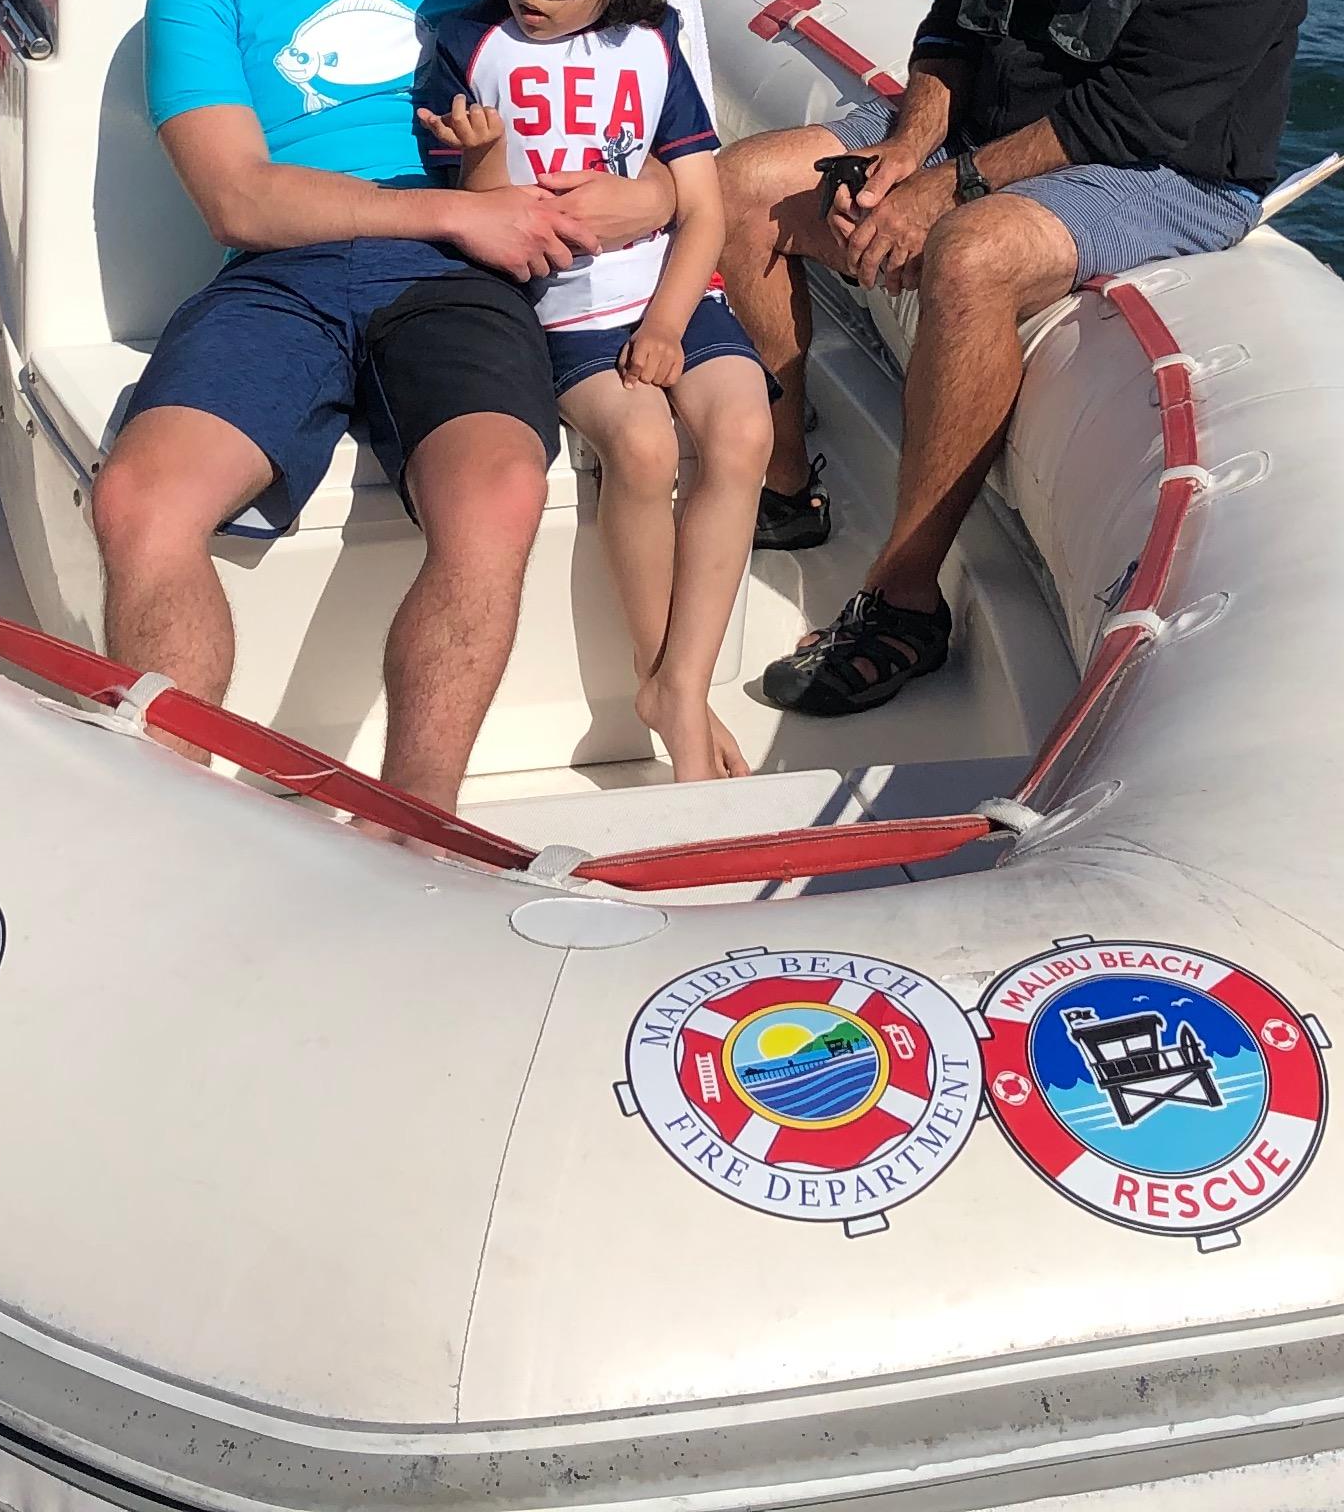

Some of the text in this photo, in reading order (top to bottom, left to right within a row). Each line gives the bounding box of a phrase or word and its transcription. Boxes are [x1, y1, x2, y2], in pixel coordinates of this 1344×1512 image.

[509, 65, 644, 140] SEA
[639, 956, 926, 1050] MALIBU BEACH
[1000, 951, 1205, 1012] MALIBU BEACH
[664, 1053, 971, 1208] FIRE DEPARTMENT
[1111, 1139, 1292, 1220] RESCUE
